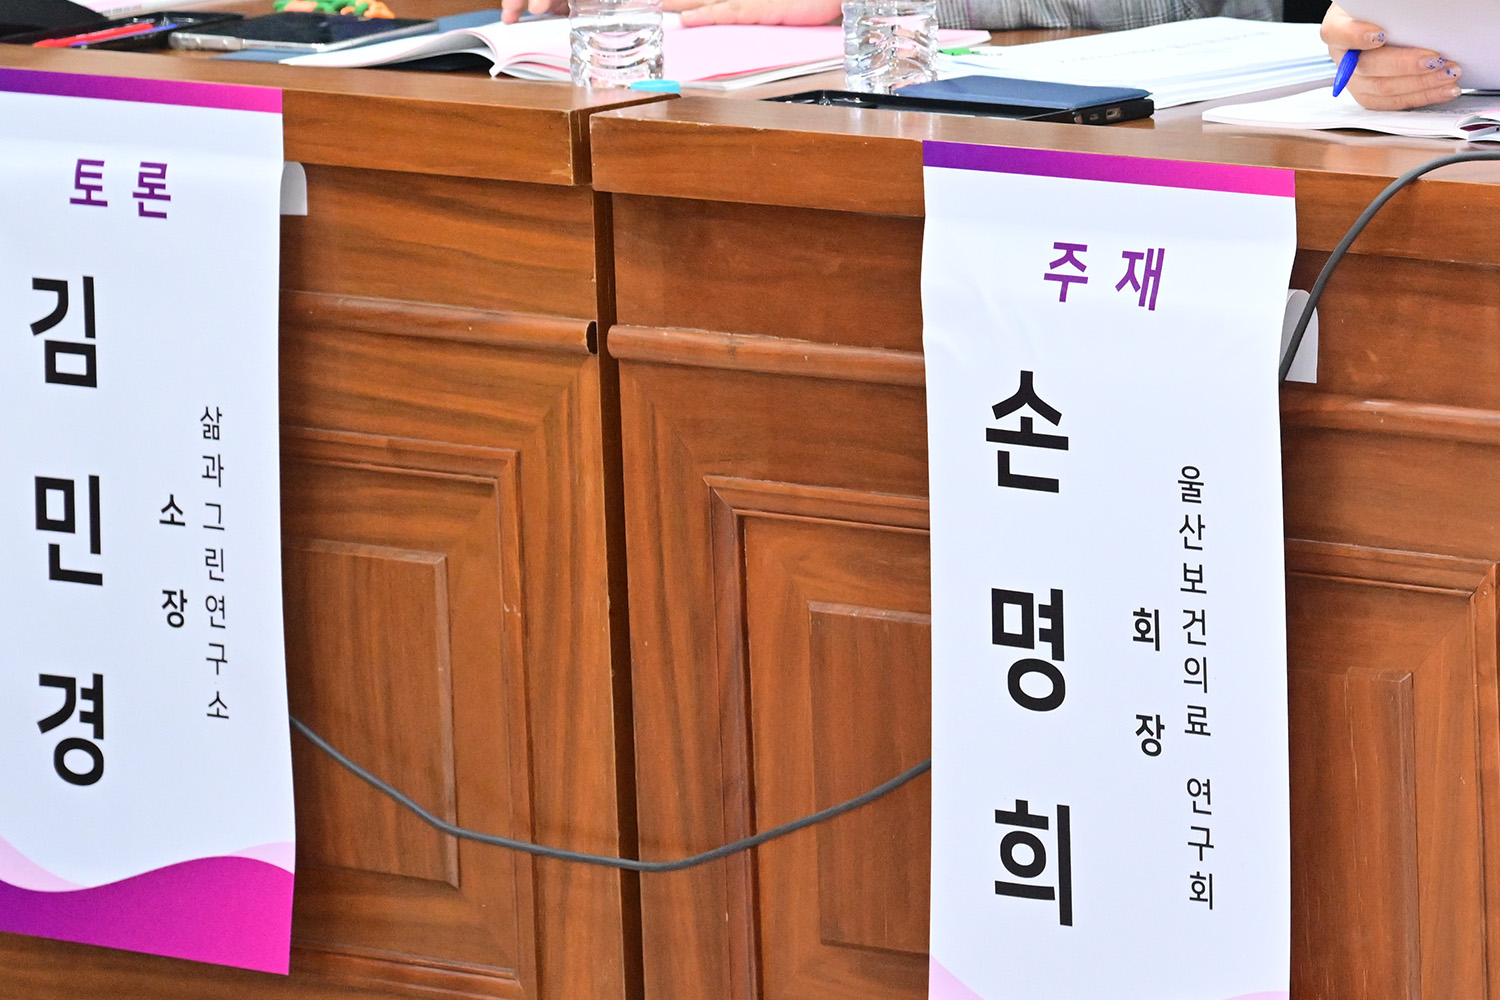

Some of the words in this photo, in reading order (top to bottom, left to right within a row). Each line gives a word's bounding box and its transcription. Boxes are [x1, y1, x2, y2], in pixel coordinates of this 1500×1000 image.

[69, 158, 173, 220] 토론
[1043, 241, 1166, 312] 주재
[29, 275, 106, 787] 김민경
[159, 493, 188, 629] 소장
[200, 405, 230, 721] 삶과그린연구소
[1177, 465, 1213, 738] 울산보건의료
[985, 369, 1073, 928] 손명희
[1132, 606, 1166, 757] 회장
[1186, 777, 1215, 911] 연구회
